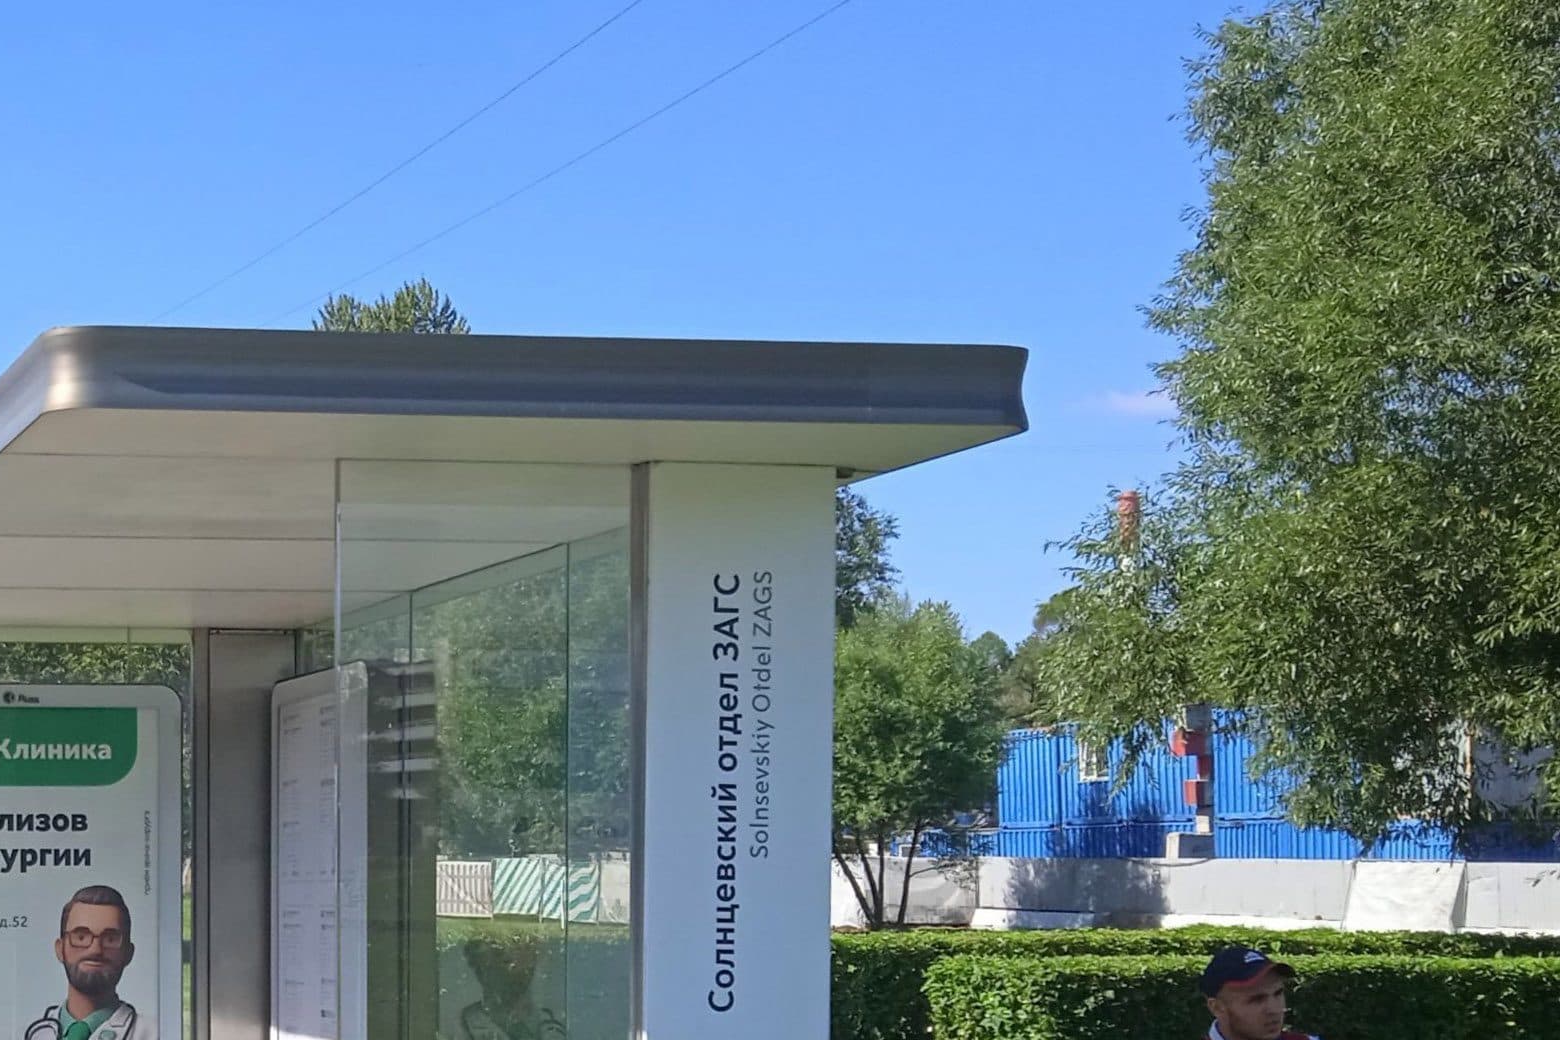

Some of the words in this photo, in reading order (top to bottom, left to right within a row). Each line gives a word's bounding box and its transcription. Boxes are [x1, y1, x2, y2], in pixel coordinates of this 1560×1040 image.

[712, 573, 741, 662] ЗАГС
[752, 571, 773, 637] ZAGS
[718, 673, 743, 773] отдел
[751, 646, 772, 713] Otdel
[750, 719, 775, 859] Solnsevskiy
[708, 782, 740, 1013] Солнцевский
